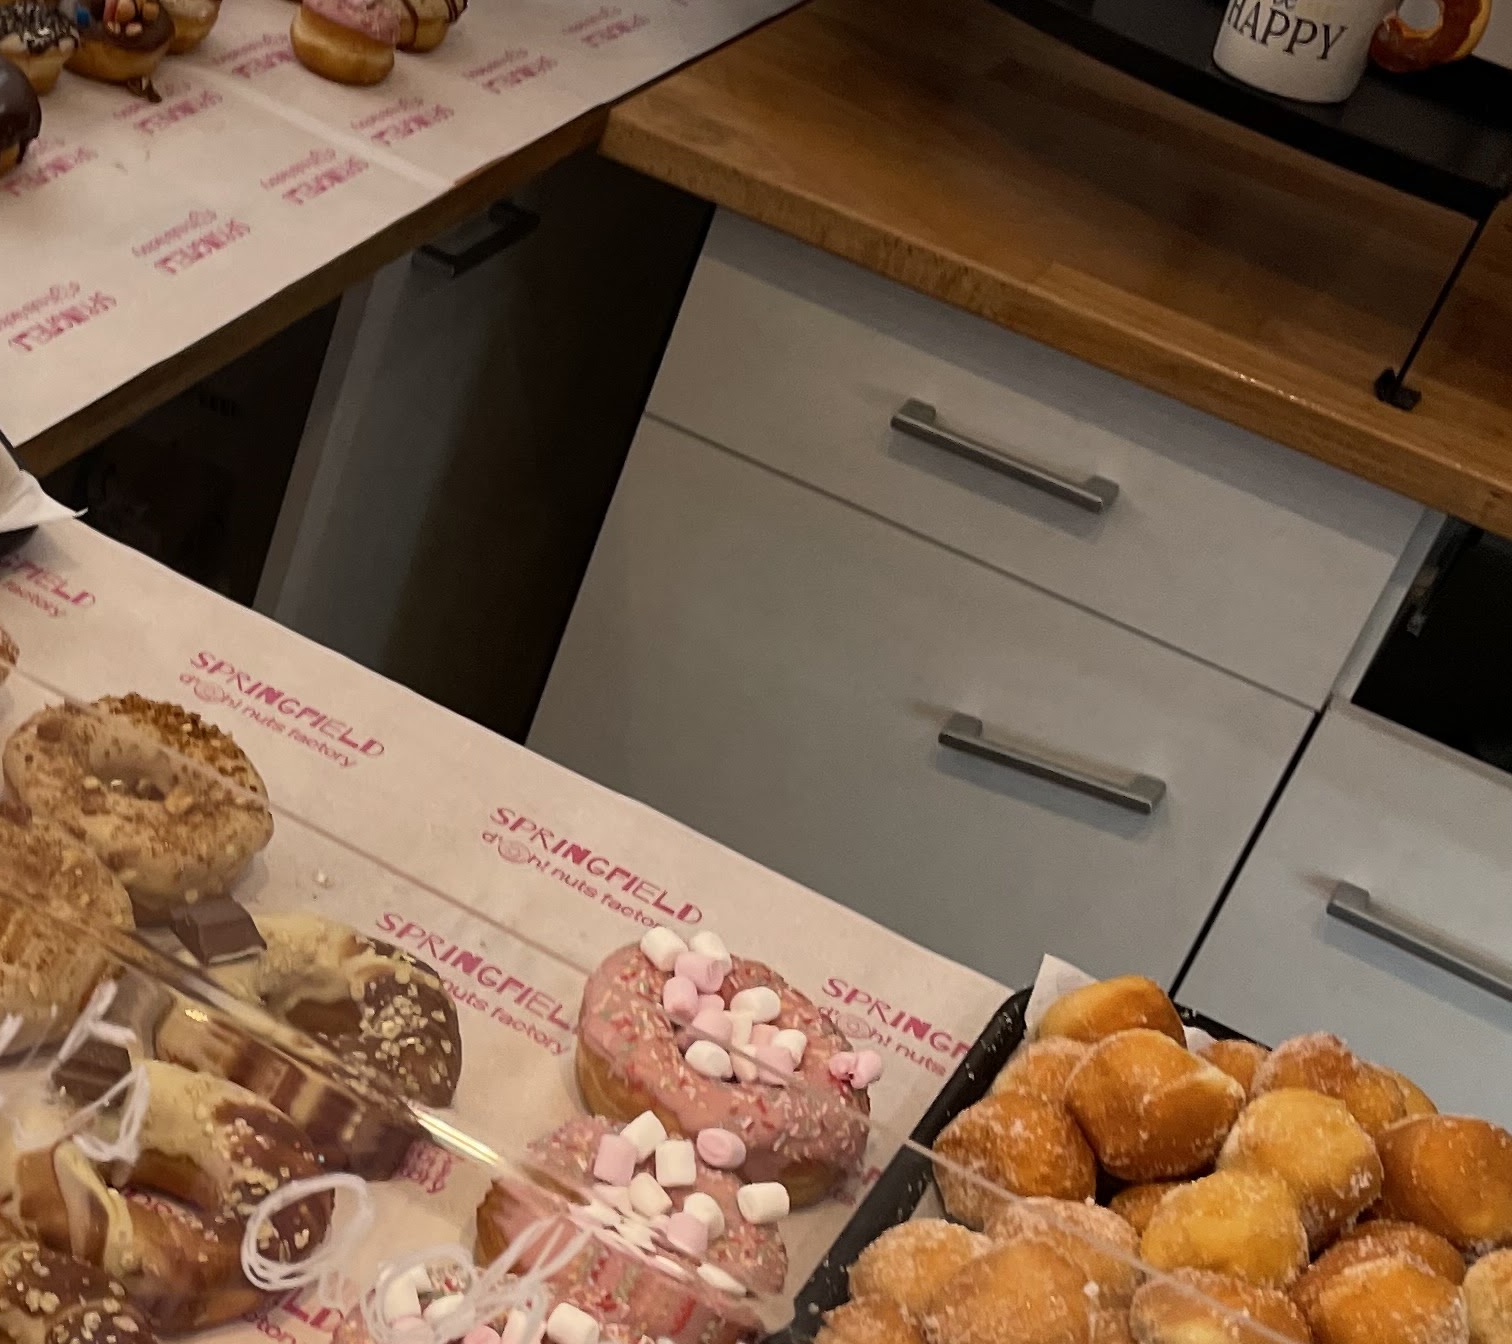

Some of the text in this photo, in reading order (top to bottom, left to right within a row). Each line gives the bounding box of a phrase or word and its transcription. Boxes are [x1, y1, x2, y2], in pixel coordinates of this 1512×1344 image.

[189, 650, 386, 757] SPRINGFIELD
[489, 807, 703, 925] SPRINGFIELD
[600, 891, 666, 931] factor
[376, 911, 578, 1034] SPRINGFIEL
